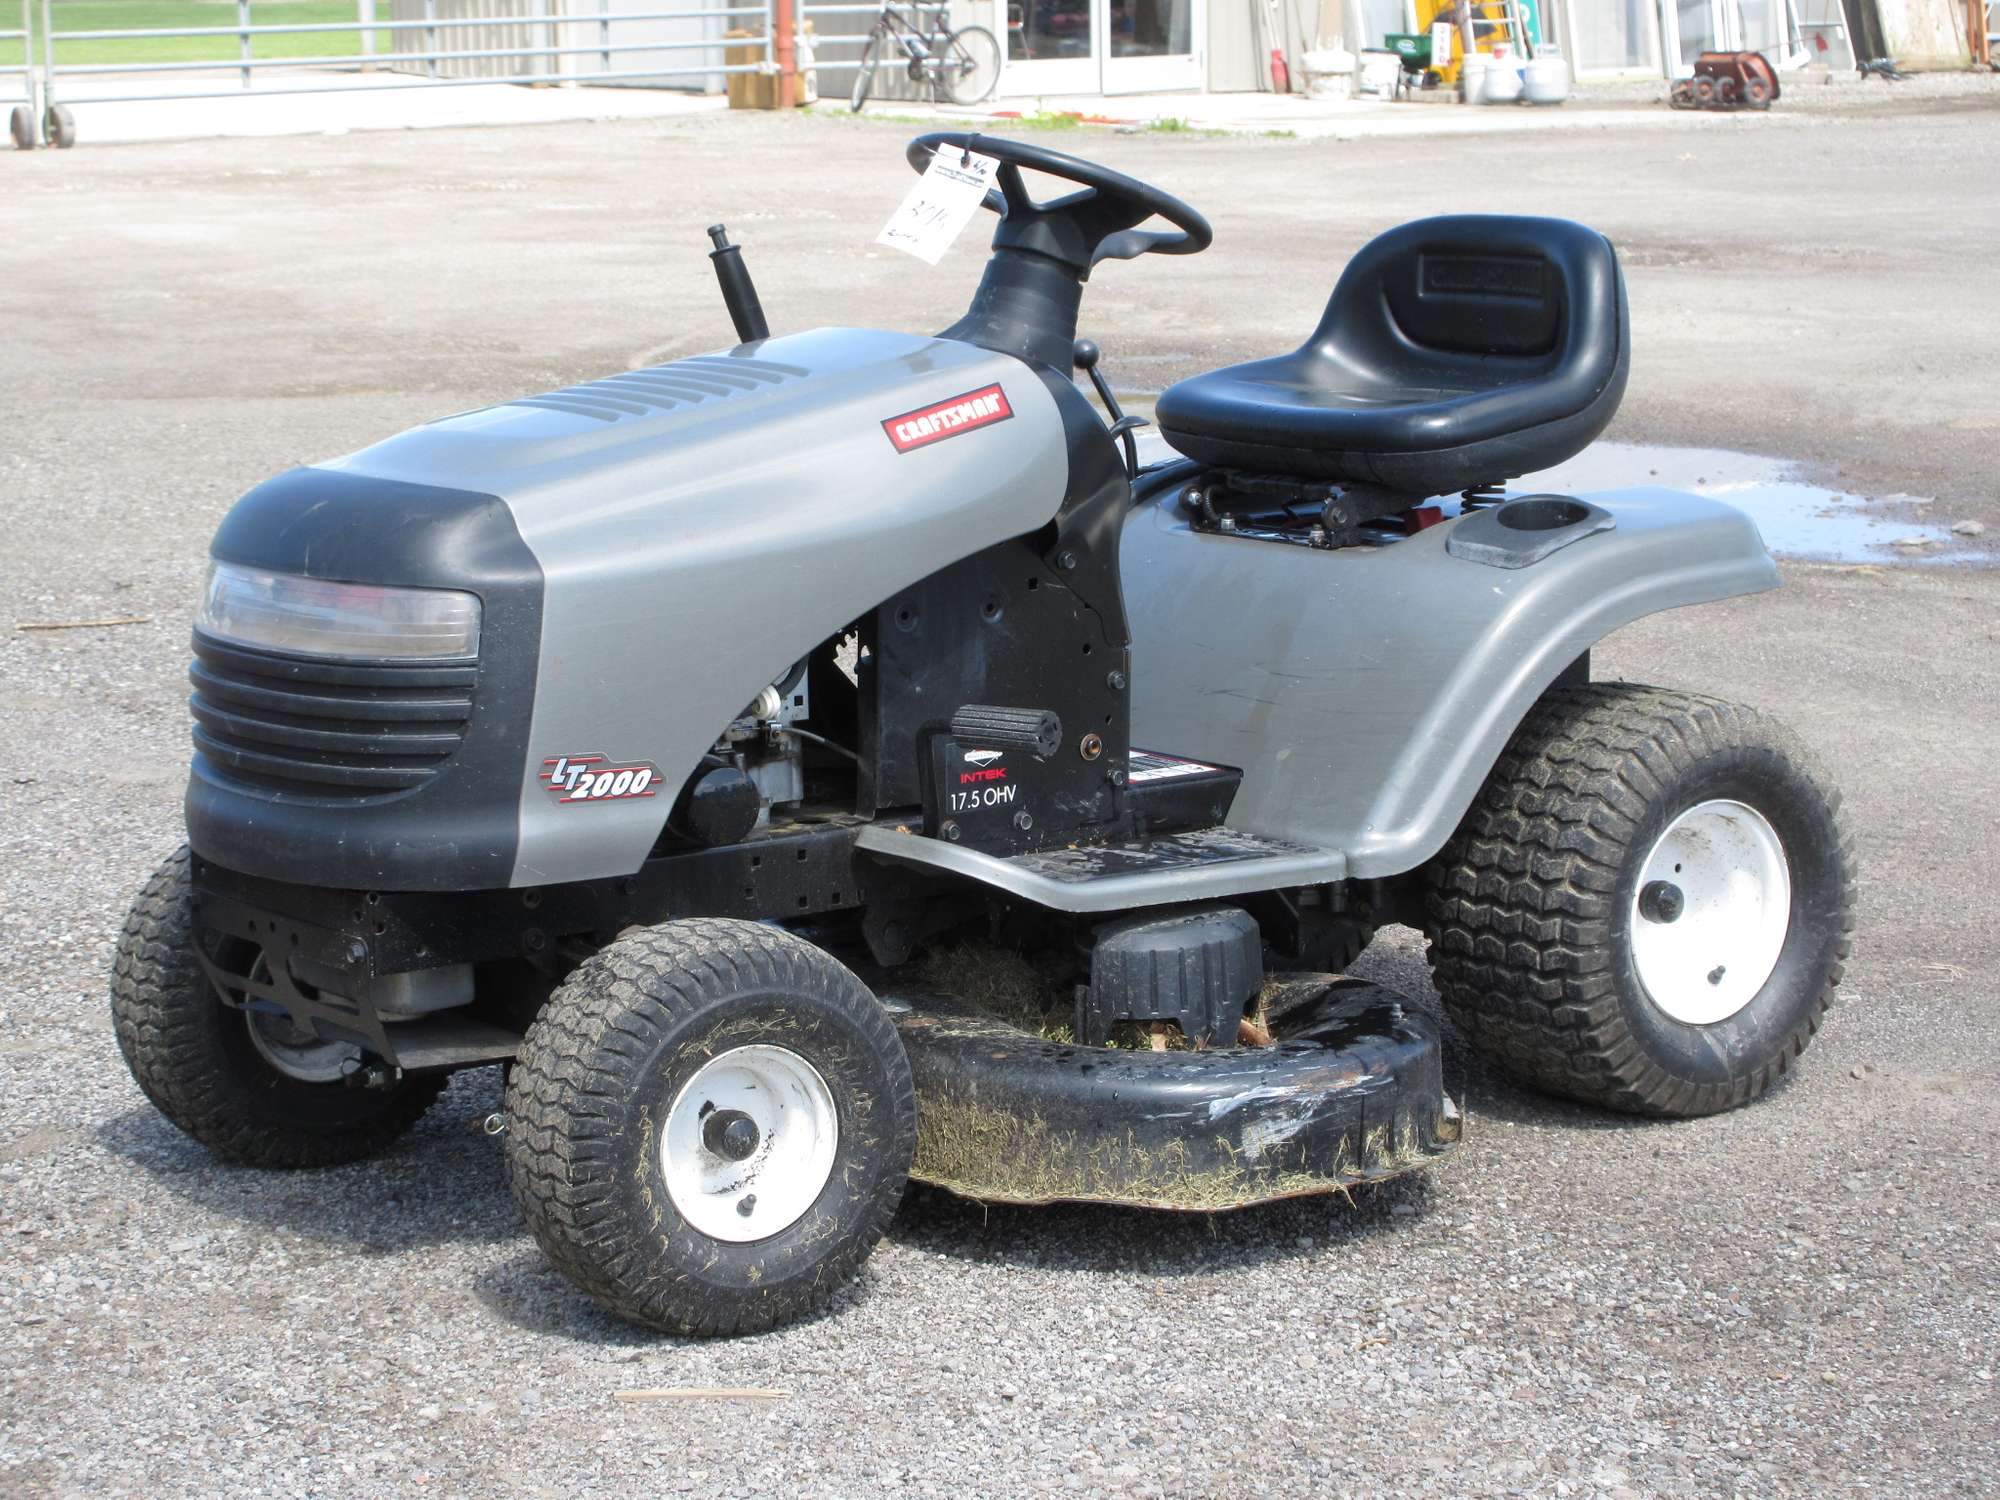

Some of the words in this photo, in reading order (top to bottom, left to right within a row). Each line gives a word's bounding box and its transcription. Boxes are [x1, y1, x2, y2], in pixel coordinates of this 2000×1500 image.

[895, 392, 1001, 442] CRAFTSMAN
[960, 768, 1008, 784] INTEK
[950, 790, 980, 811] 17.5
[983, 784, 1017, 806] OHV
